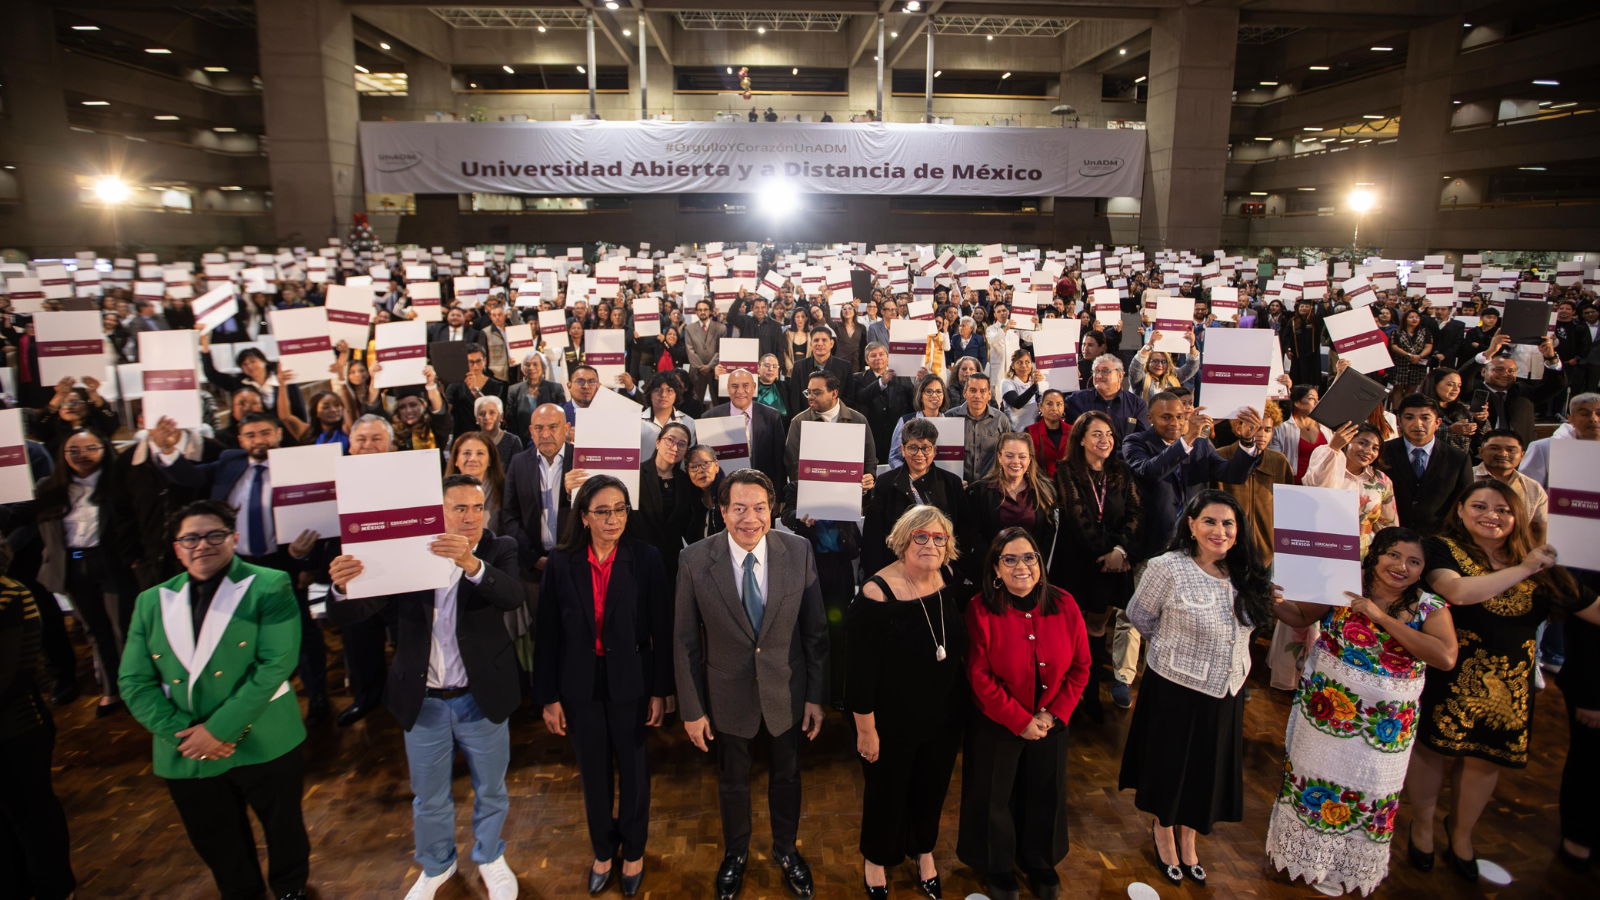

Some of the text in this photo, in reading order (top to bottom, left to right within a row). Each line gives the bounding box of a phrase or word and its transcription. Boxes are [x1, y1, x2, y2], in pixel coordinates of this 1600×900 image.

[665, 142, 847, 155] #OrgulloYCorazónUnADM
[461, 160, 1043, 181] Universidad Abierta y a Distancia de México
[1571, 502, 1599, 510] MÉXICO
[390, 518, 419, 526] EDUCACIÓN
